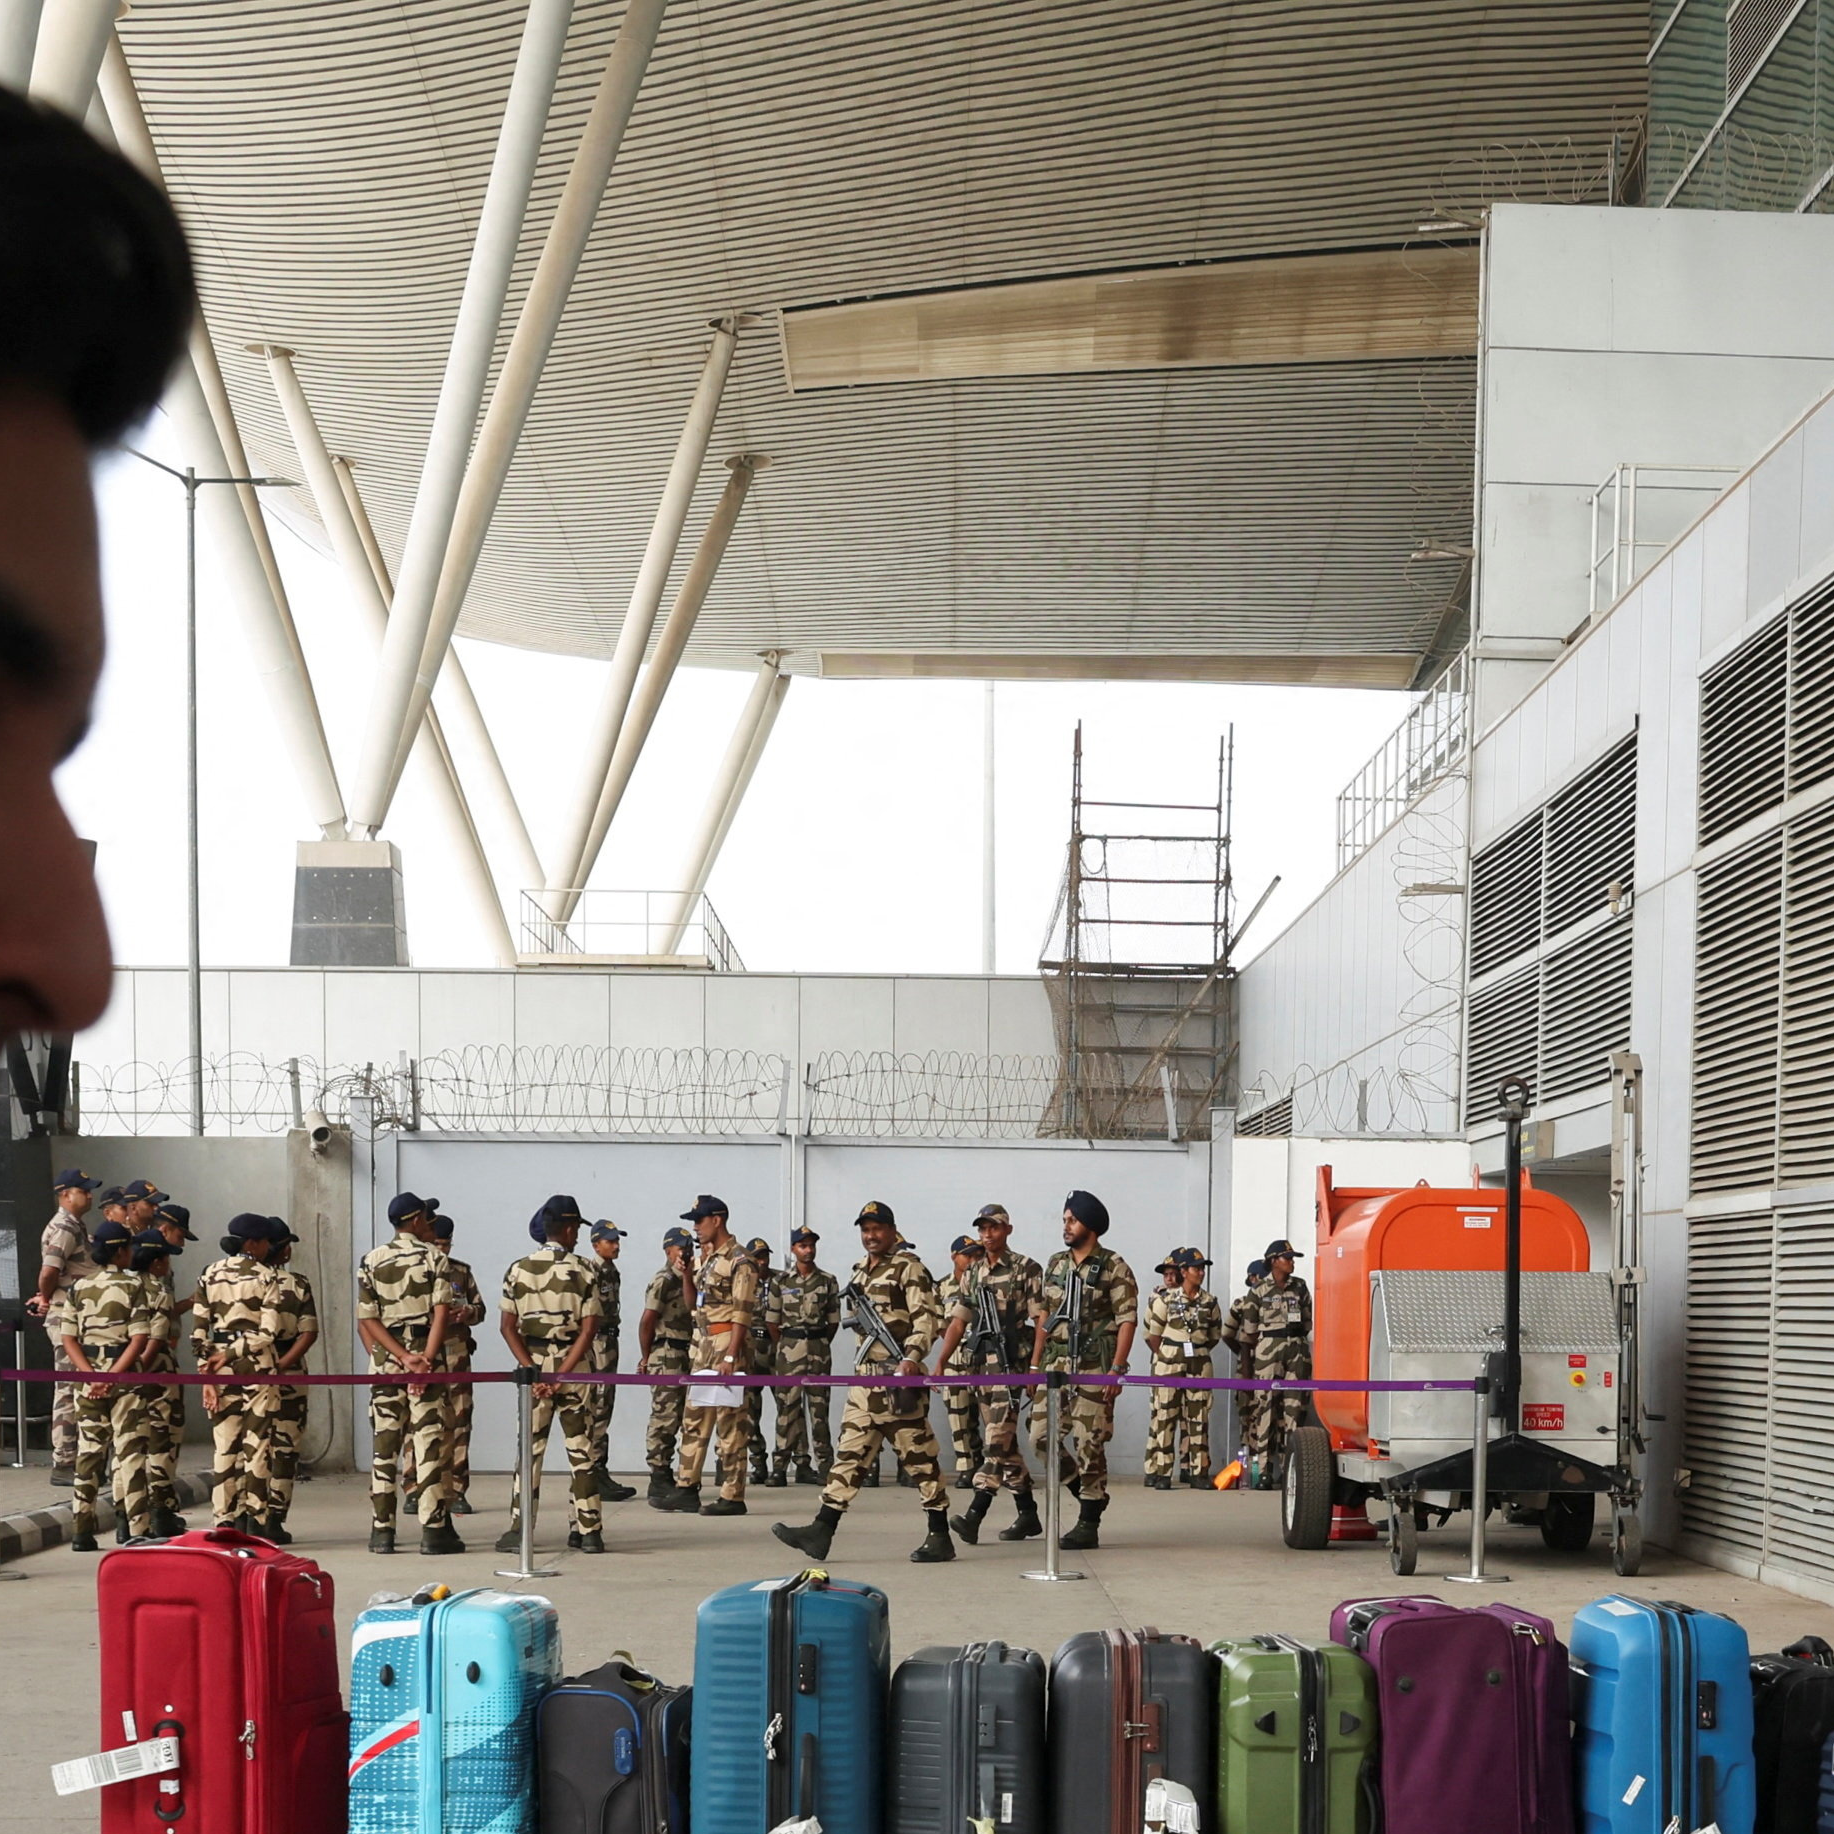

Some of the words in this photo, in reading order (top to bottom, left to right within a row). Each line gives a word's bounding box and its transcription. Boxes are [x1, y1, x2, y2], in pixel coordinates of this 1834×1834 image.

[1524, 1417, 1537, 1428] 40
[1538, 1417, 1563, 1428] km/h
[162, 1741, 174, 1763] GOX
